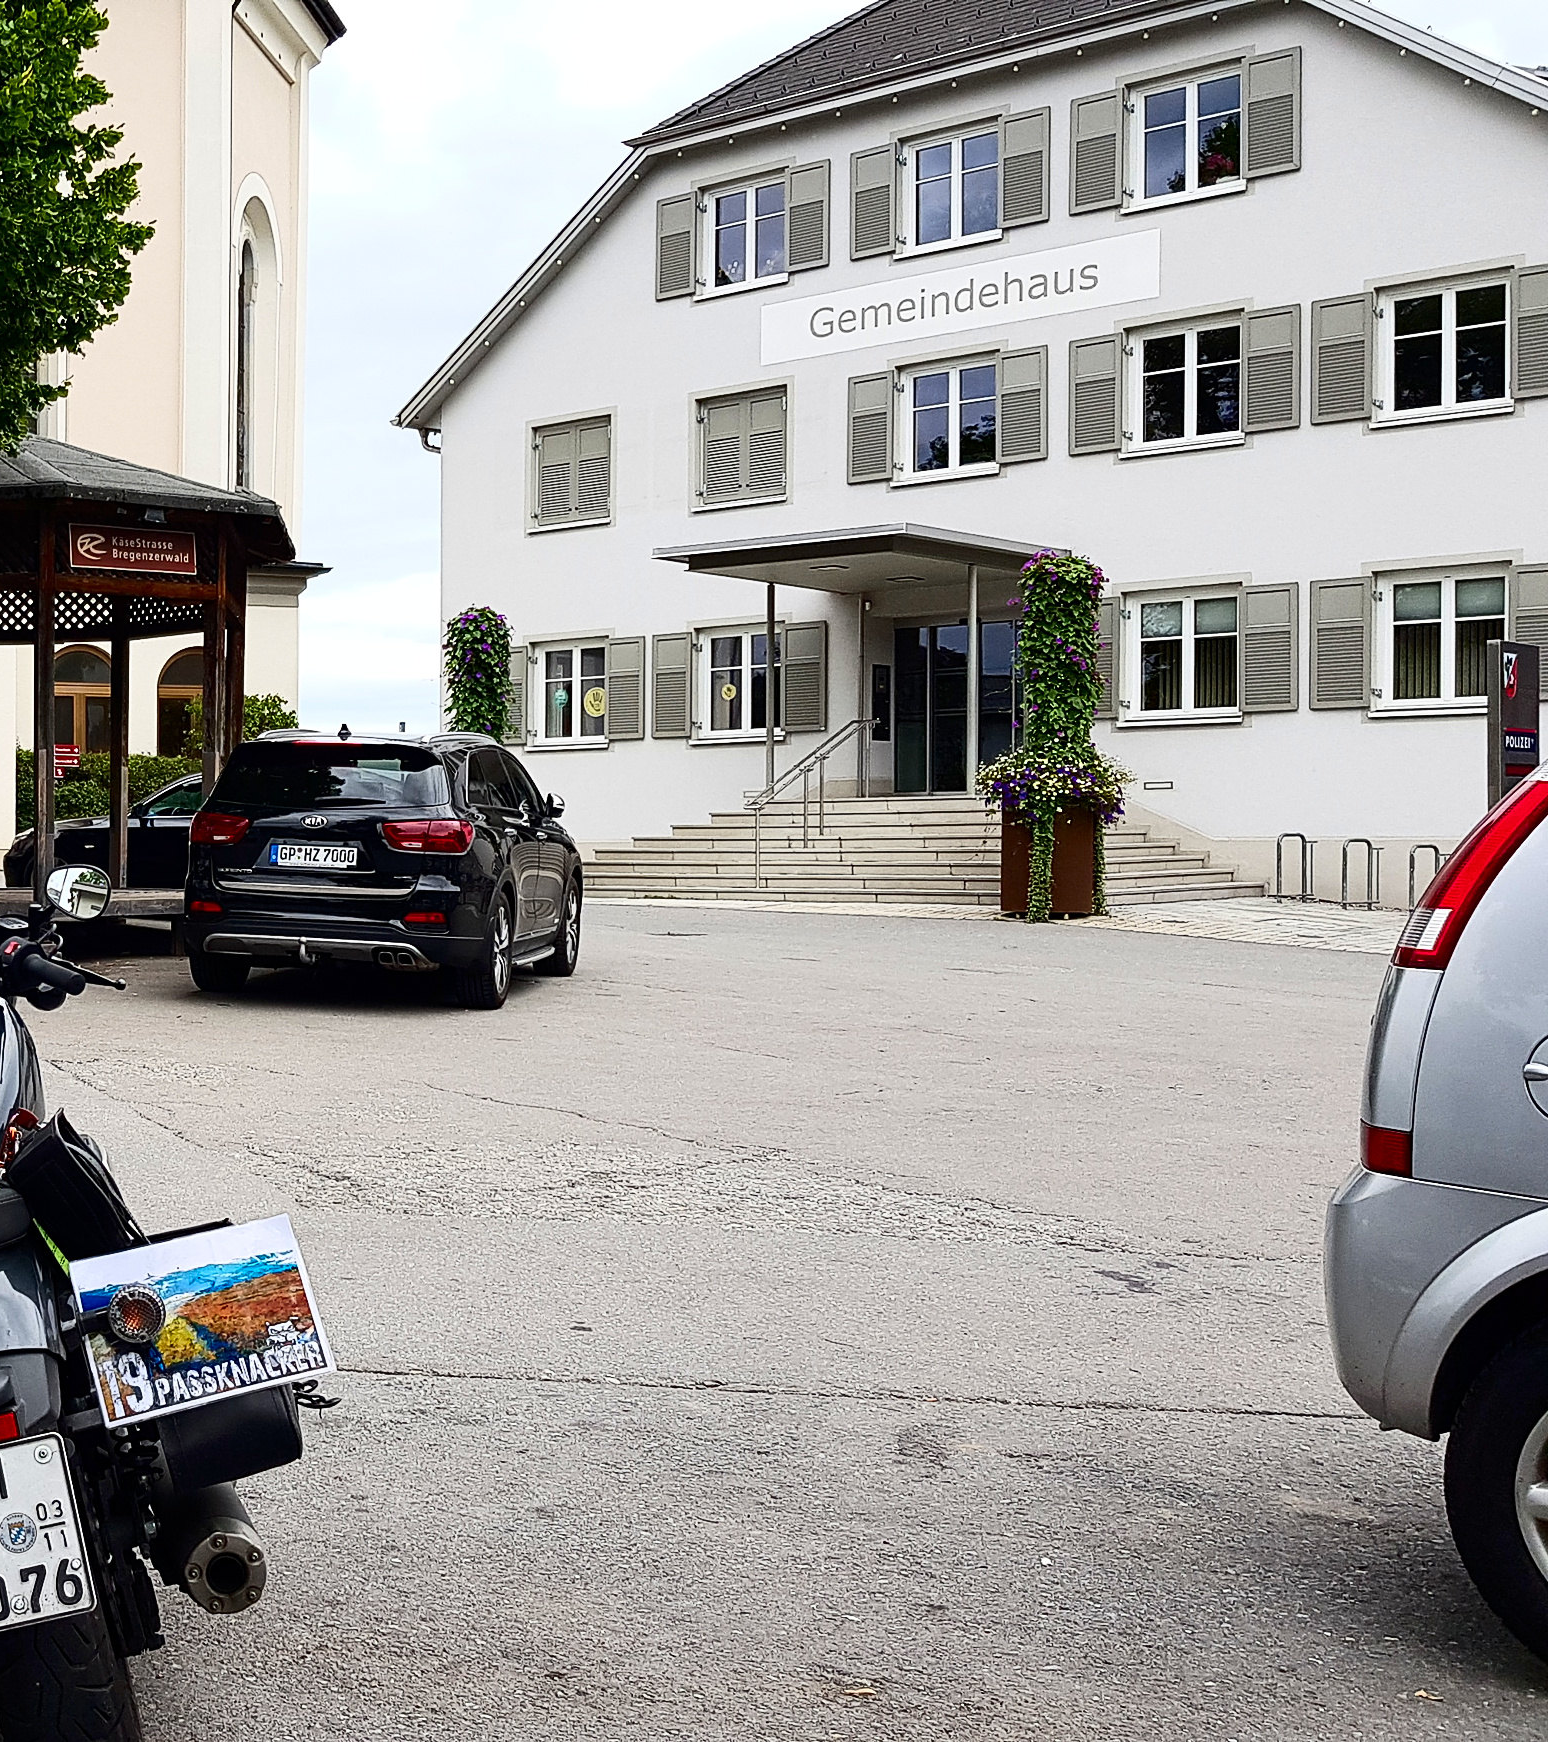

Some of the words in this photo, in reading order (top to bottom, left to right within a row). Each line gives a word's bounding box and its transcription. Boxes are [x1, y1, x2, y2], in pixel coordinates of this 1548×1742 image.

[809, 263, 1100, 338] Gemeindehaus
[112, 536, 173, 550] KäseStrasse
[112, 549, 189, 563] Bregenzerwald
[1505, 735, 1531, 749] POLIZEI
[303, 816, 325, 826] KIA
[280, 847, 296, 861] GP
[304, 848, 320, 862] HZ
[323, 849, 356, 863] 7000
[100, 1351, 153, 1418] 19
[155, 1340, 325, 1406] PASSKNACKER
[36, 1499, 64, 1521] 03
[19, 1558, 84, 1614] 76
